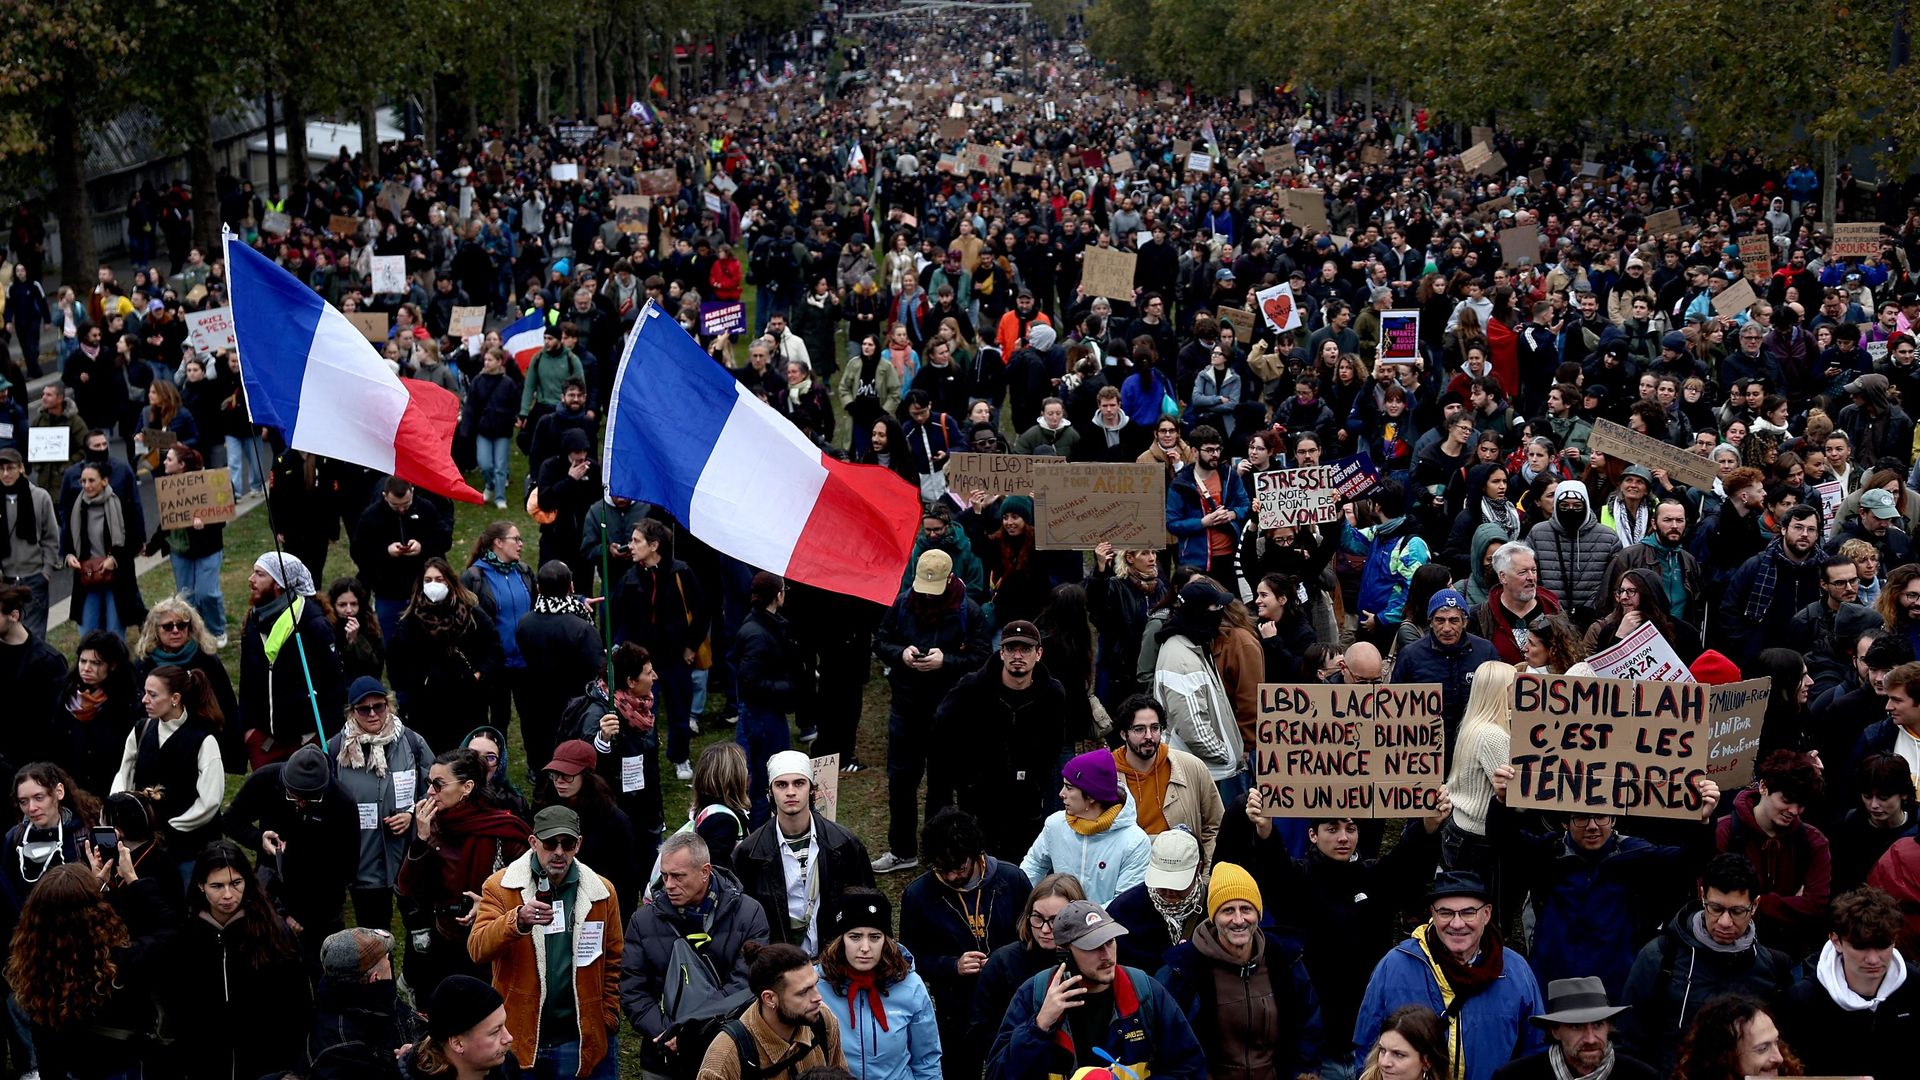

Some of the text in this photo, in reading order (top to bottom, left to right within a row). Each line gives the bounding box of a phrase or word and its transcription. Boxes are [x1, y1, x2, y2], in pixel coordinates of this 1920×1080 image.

[1834, 242, 1878, 254] ORDURES
[161, 474, 204, 491] PANEM
[954, 474, 989, 493] MACRON
[1004, 477, 1014, 493] LA
[1014, 475, 1034, 489] POU
[1091, 475, 1135, 493] AGIR
[1333, 472, 1345, 484] DES
[1338, 480, 1353, 495] USSE
[1352, 472, 1365, 485] DES
[161, 493, 207, 513] PANAME
[1259, 490, 1308, 501] DES NOTES
[1259, 496, 1333, 512] AU POINT DE
[193, 504, 234, 518] COMBAT
[1282, 505, 1336, 524] VOMIR
[1619, 655, 1658, 680] GAZA
[1331, 687, 1442, 719] LACRYMO
[1514, 674, 1705, 726] BISMILLAH
[1529, 720, 1695, 758] C'EST LES
[1710, 741, 1720, 759] 6
[1258, 750, 1442, 776] LA FRANCE N'EST
[1259, 782, 1438, 811] PAS UN JEU VIDÉO
